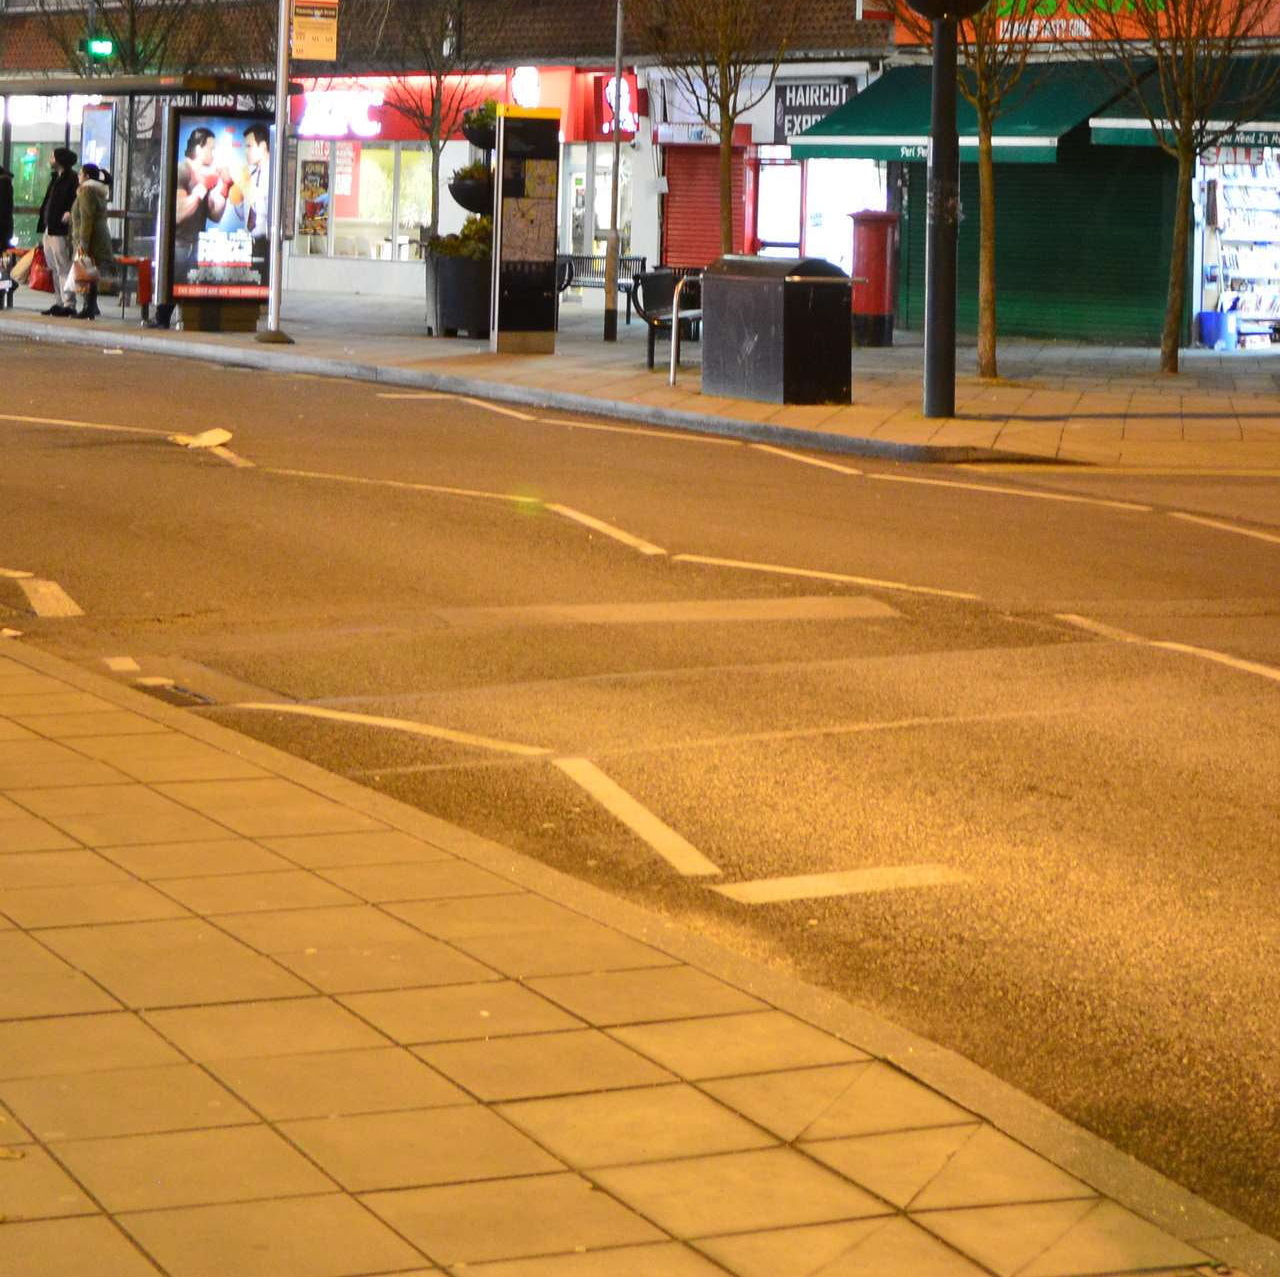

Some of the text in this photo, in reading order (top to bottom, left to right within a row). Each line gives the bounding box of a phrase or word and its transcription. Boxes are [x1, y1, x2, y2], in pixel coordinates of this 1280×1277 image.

[785, 84, 849, 107] HAIRCUT
[1235, 132, 1257, 144] Need
[1258, 133, 1269, 145] In
[1200, 145, 1263, 165] SALE
